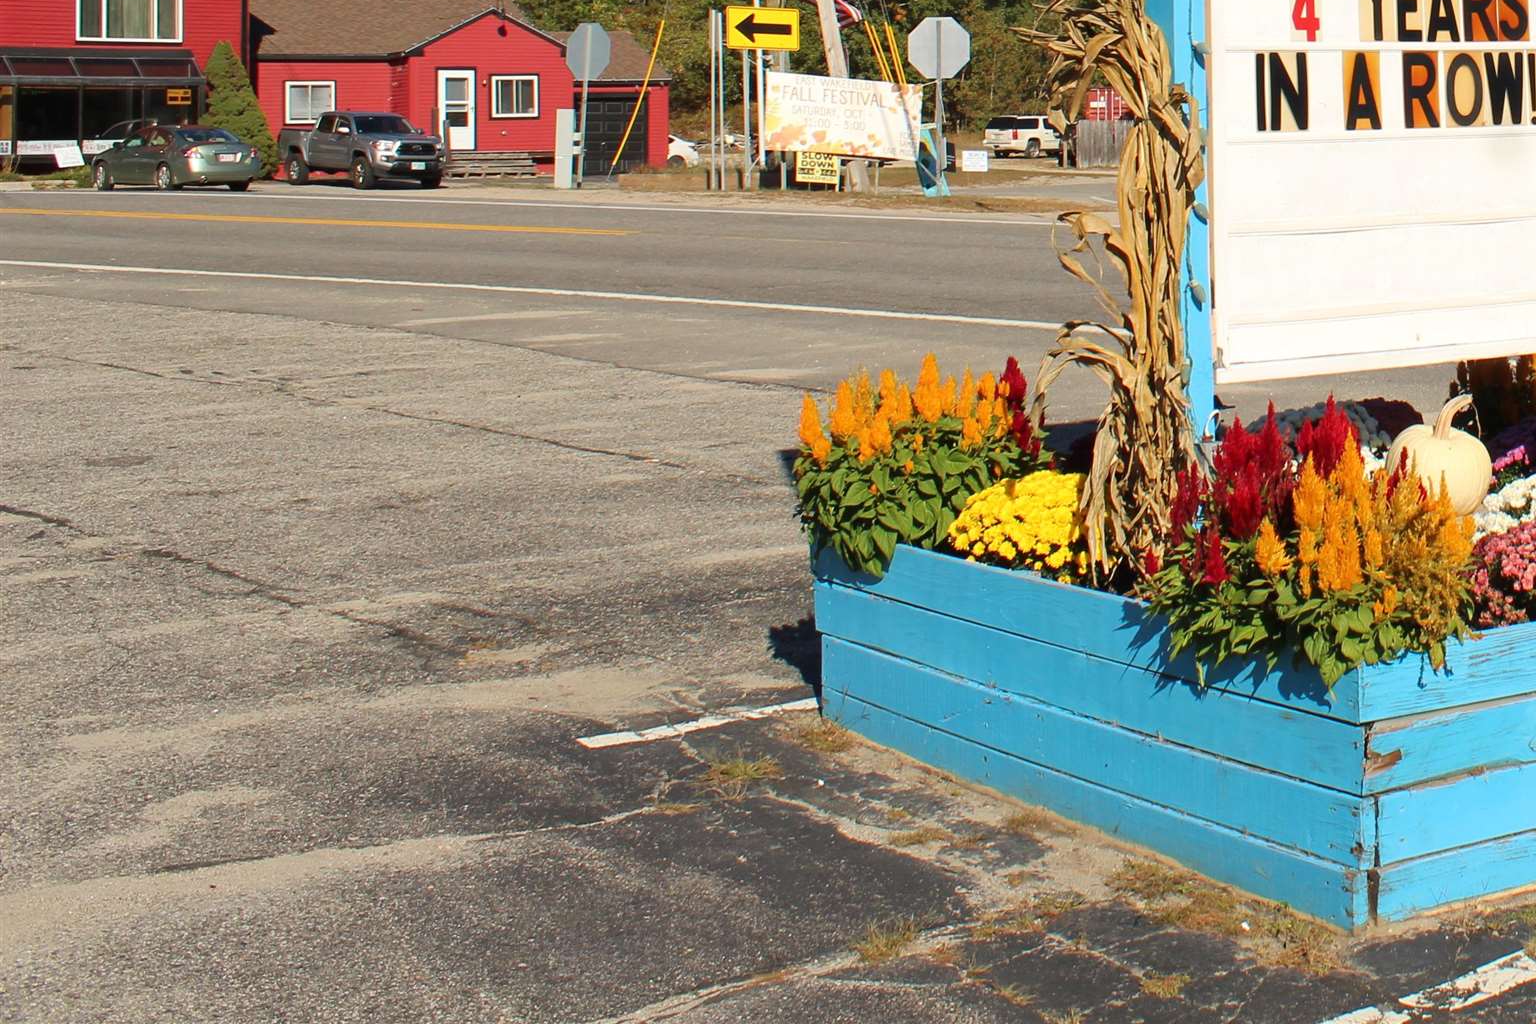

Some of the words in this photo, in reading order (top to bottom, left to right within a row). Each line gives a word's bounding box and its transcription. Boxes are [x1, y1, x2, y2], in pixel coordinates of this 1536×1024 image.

[782, 85, 816, 103] FALL
[823, 89, 888, 109] FESTIVAL
[1255, 52, 1308, 132] IN
[1346, 52, 1382, 131] A
[801, 151, 833, 161] SLOW
[801, 160, 834, 169] DOWN
